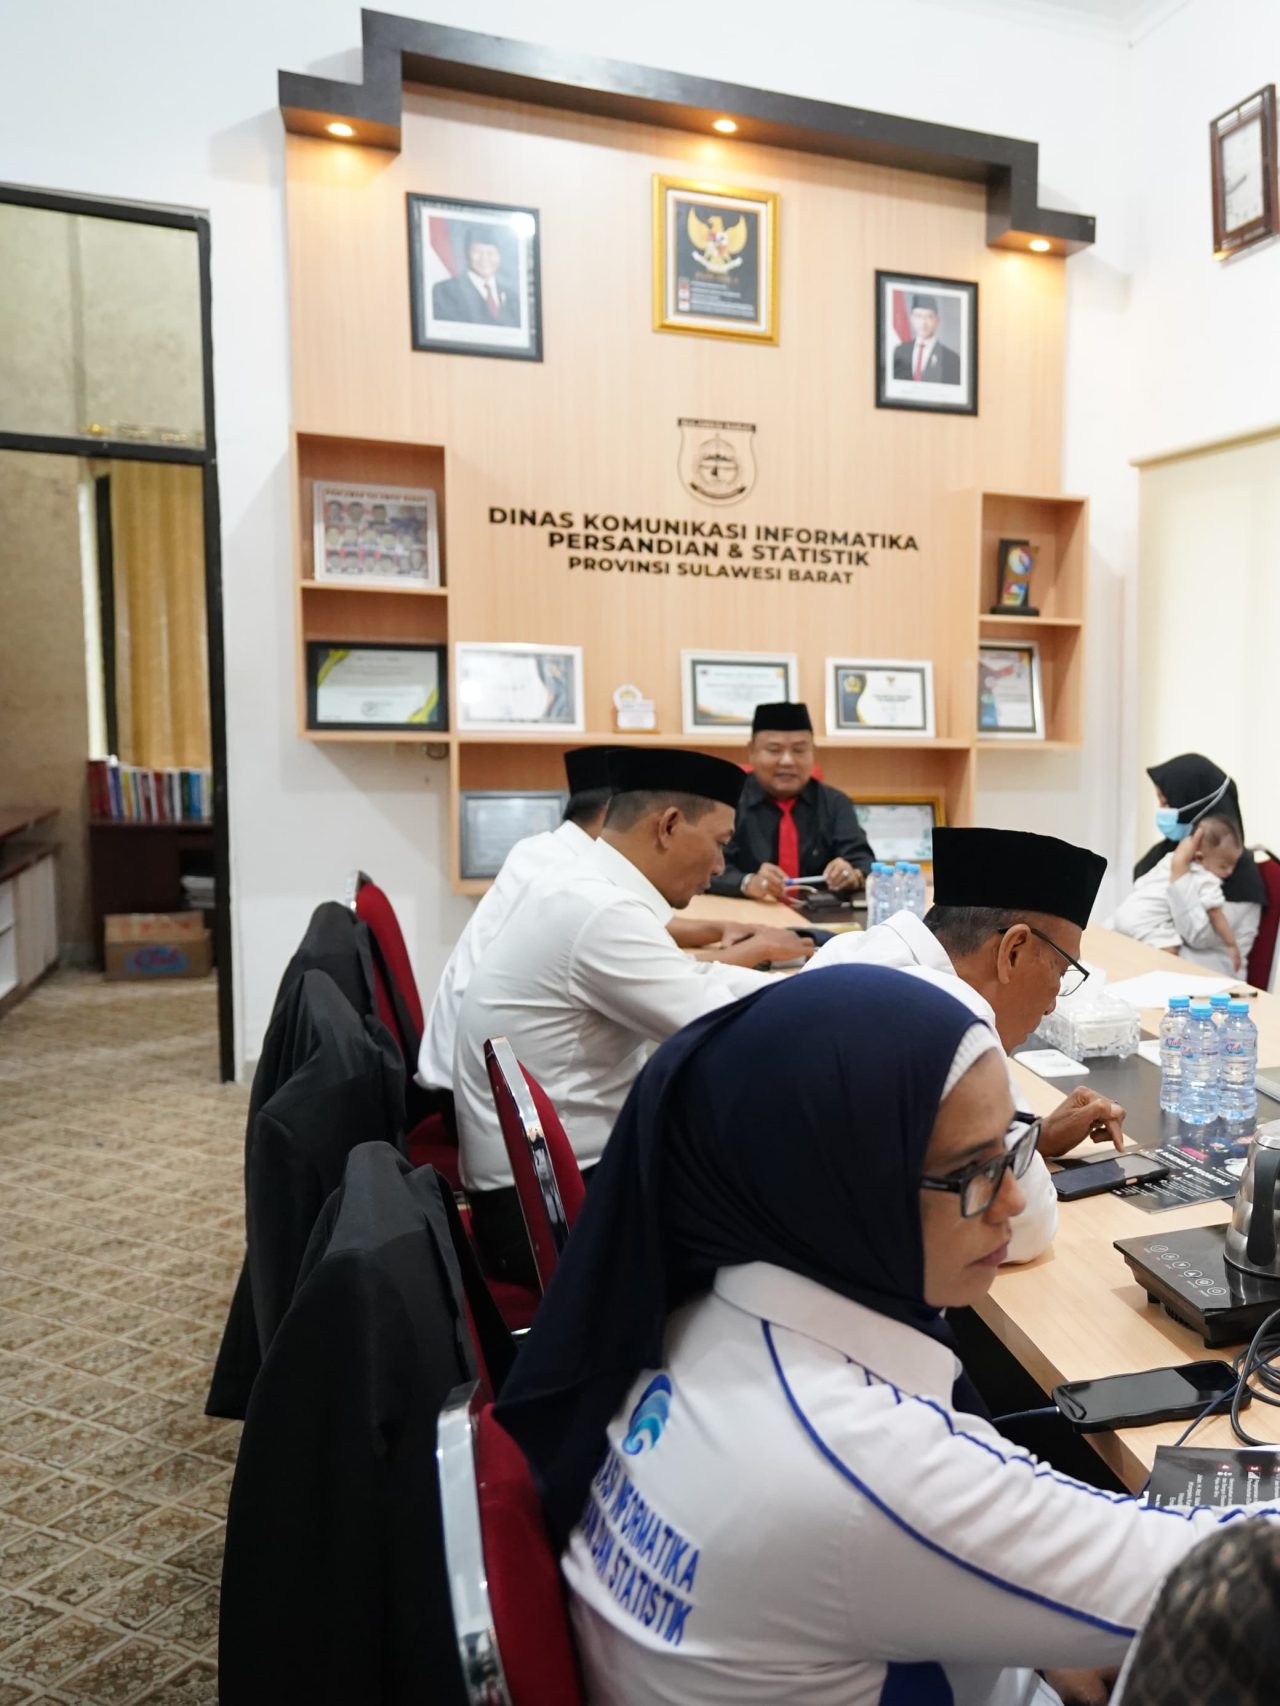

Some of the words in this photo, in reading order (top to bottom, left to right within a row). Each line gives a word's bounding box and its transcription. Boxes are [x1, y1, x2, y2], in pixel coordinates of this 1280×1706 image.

[488, 506, 574, 529] DINAS
[583, 513, 747, 541] KOMUNIKASI
[756, 525, 920, 552] INFORMATIKA
[548, 531, 719, 559] PERSANDIAN
[728, 542, 744, 559] &
[751, 544, 870, 567] STATISTIK
[568, 556, 671, 576] PROVINSI
[677, 562, 782, 581] SULAWESI
[788, 568, 854, 585] BARAT
[608, 1474, 701, 1594] INFORMATIKA
